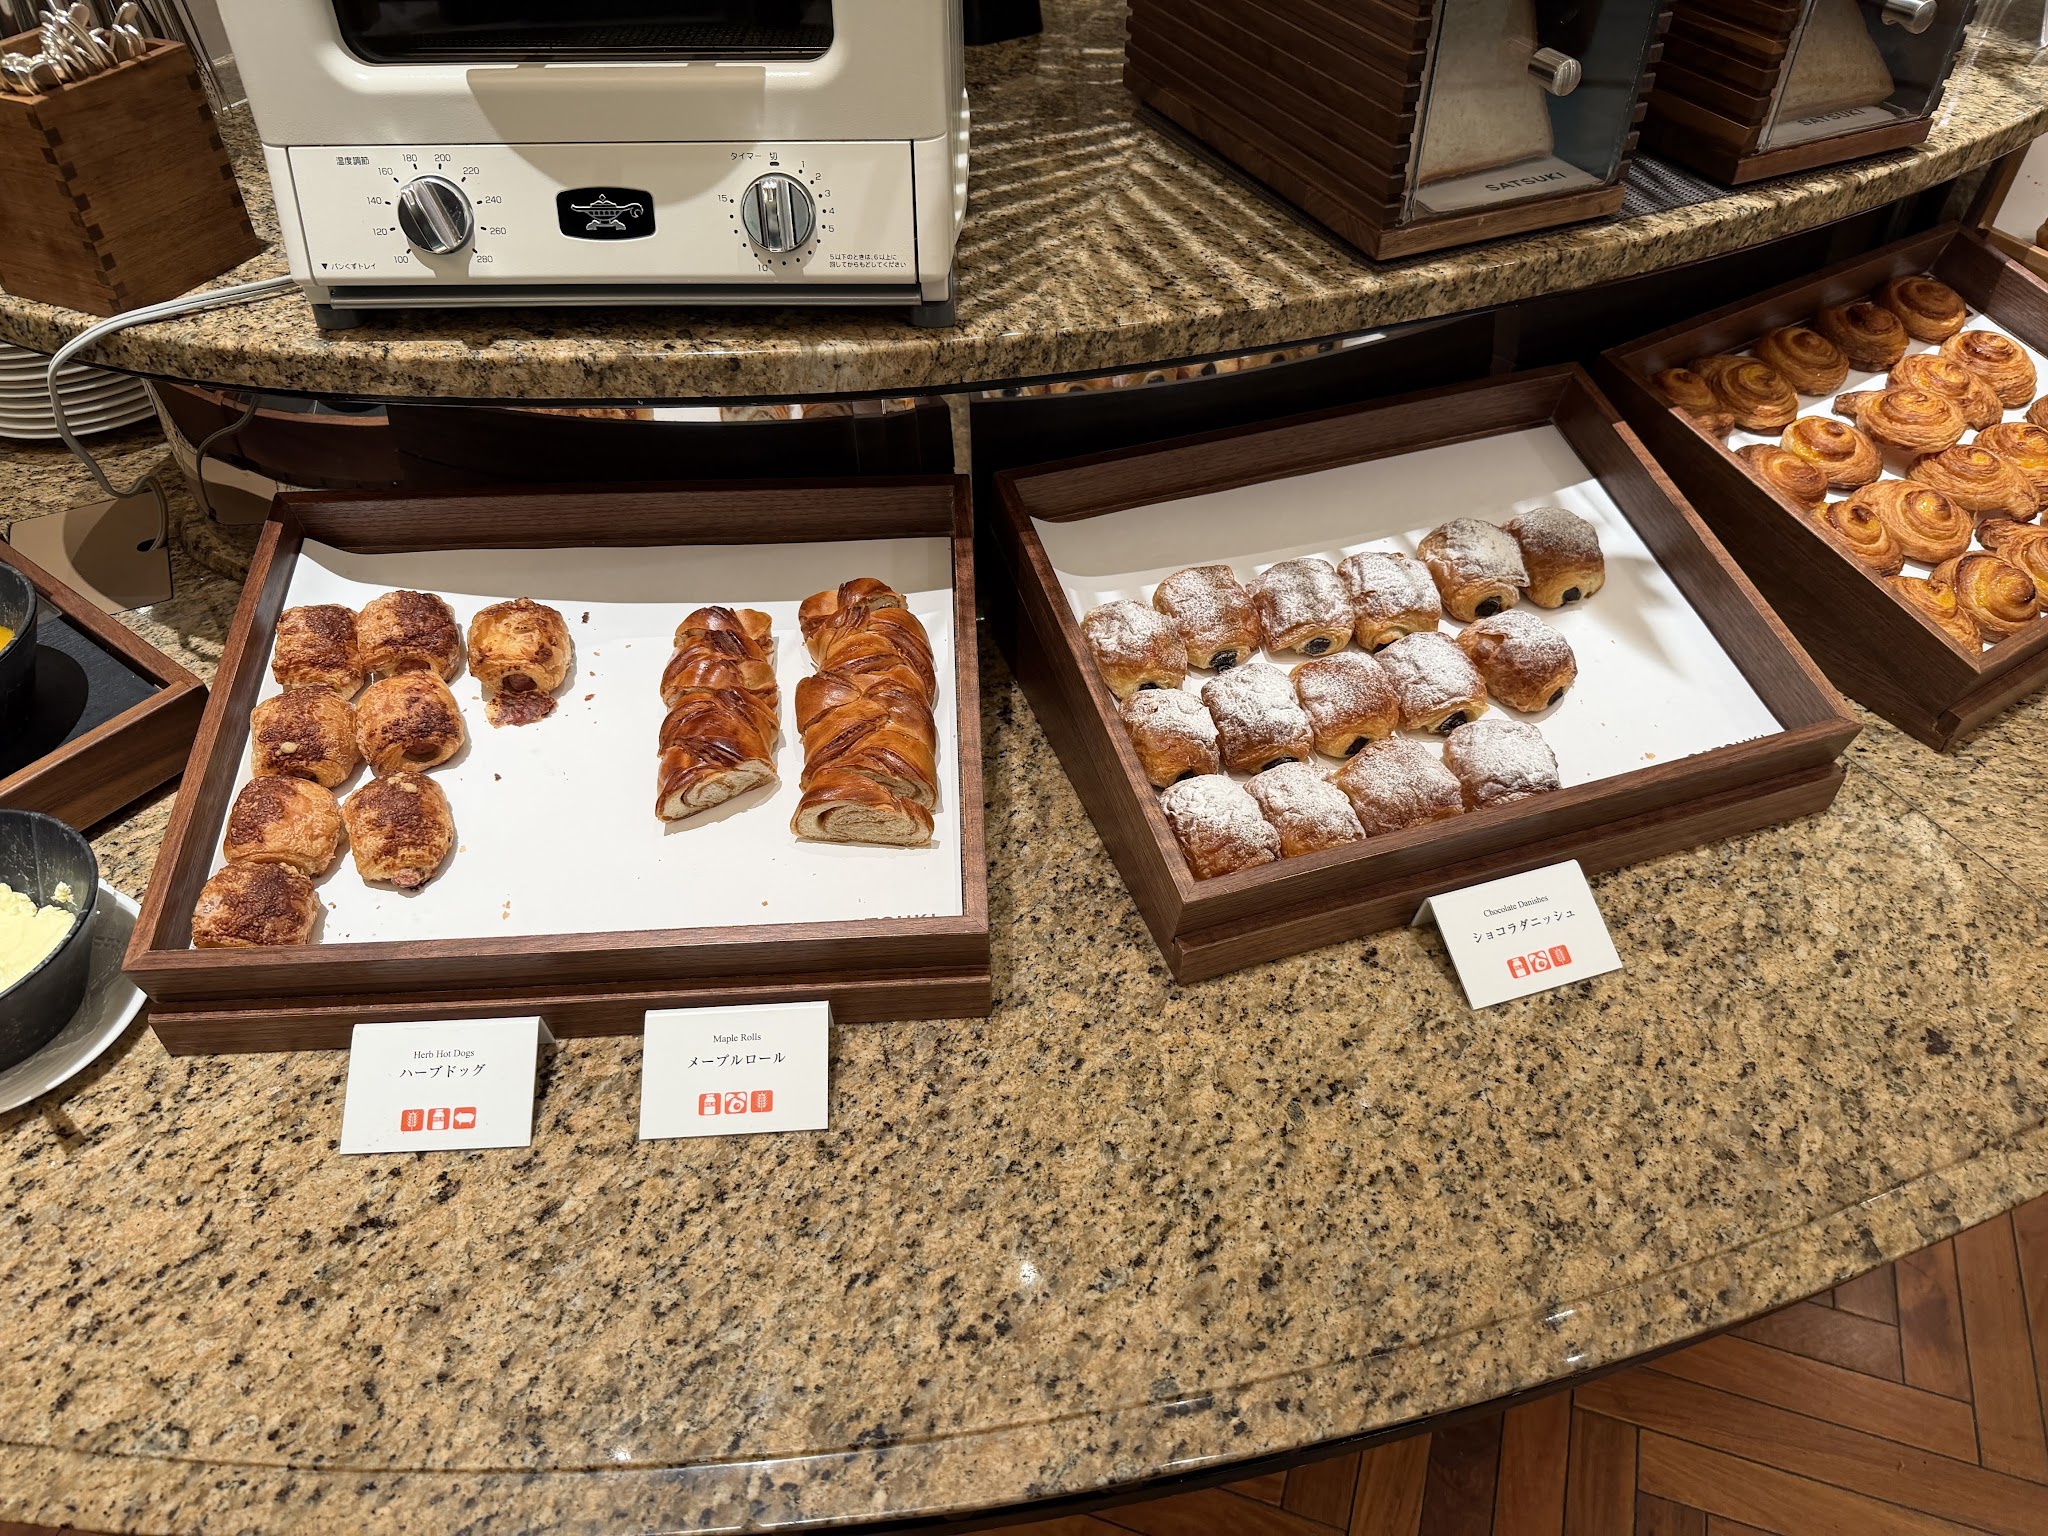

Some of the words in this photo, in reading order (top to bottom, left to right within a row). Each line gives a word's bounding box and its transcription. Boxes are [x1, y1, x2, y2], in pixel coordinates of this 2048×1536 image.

[1797, 107, 1866, 126] SATSUKI
[335, 156, 370, 166] 温度調節
[402, 153, 418, 162] 180
[434, 153, 451, 162] 200
[730, 152, 762, 161] タイマー
[769, 152, 778, 161] 切
[378, 167, 393, 176] 160
[462, 166, 480, 175] 220
[815, 173, 822, 181] 2
[1485, 172, 1567, 192] SATSUKI
[717, 194, 728, 202] 15
[824, 189, 831, 198] 3
[367, 196, 382, 205] 140
[485, 196, 502, 204] 240
[828, 207, 835, 215] 4
[372, 228, 388, 236] 120
[490, 227, 507, 235] 260
[828, 224, 835, 233] 5
[394, 255, 409, 264] 100
[476, 255, 493, 264] 280
[757, 264, 768, 272] 10
[1483, 902, 1517, 918] Chocolate
[1518, 895, 1549, 909] Danishes
[1472, 909, 1576, 943] ショコラダニッシュ
[713, 1034, 738, 1044] Maple
[740, 1033, 762, 1041] Rolls
[413, 1050, 434, 1059] Herb
[436, 1049, 451, 1058] Hot
[453, 1049, 475, 1059] Dogs
[687, 1052, 786, 1068] メープルロール
[399, 1063, 486, 1078] ハーブドッグ
